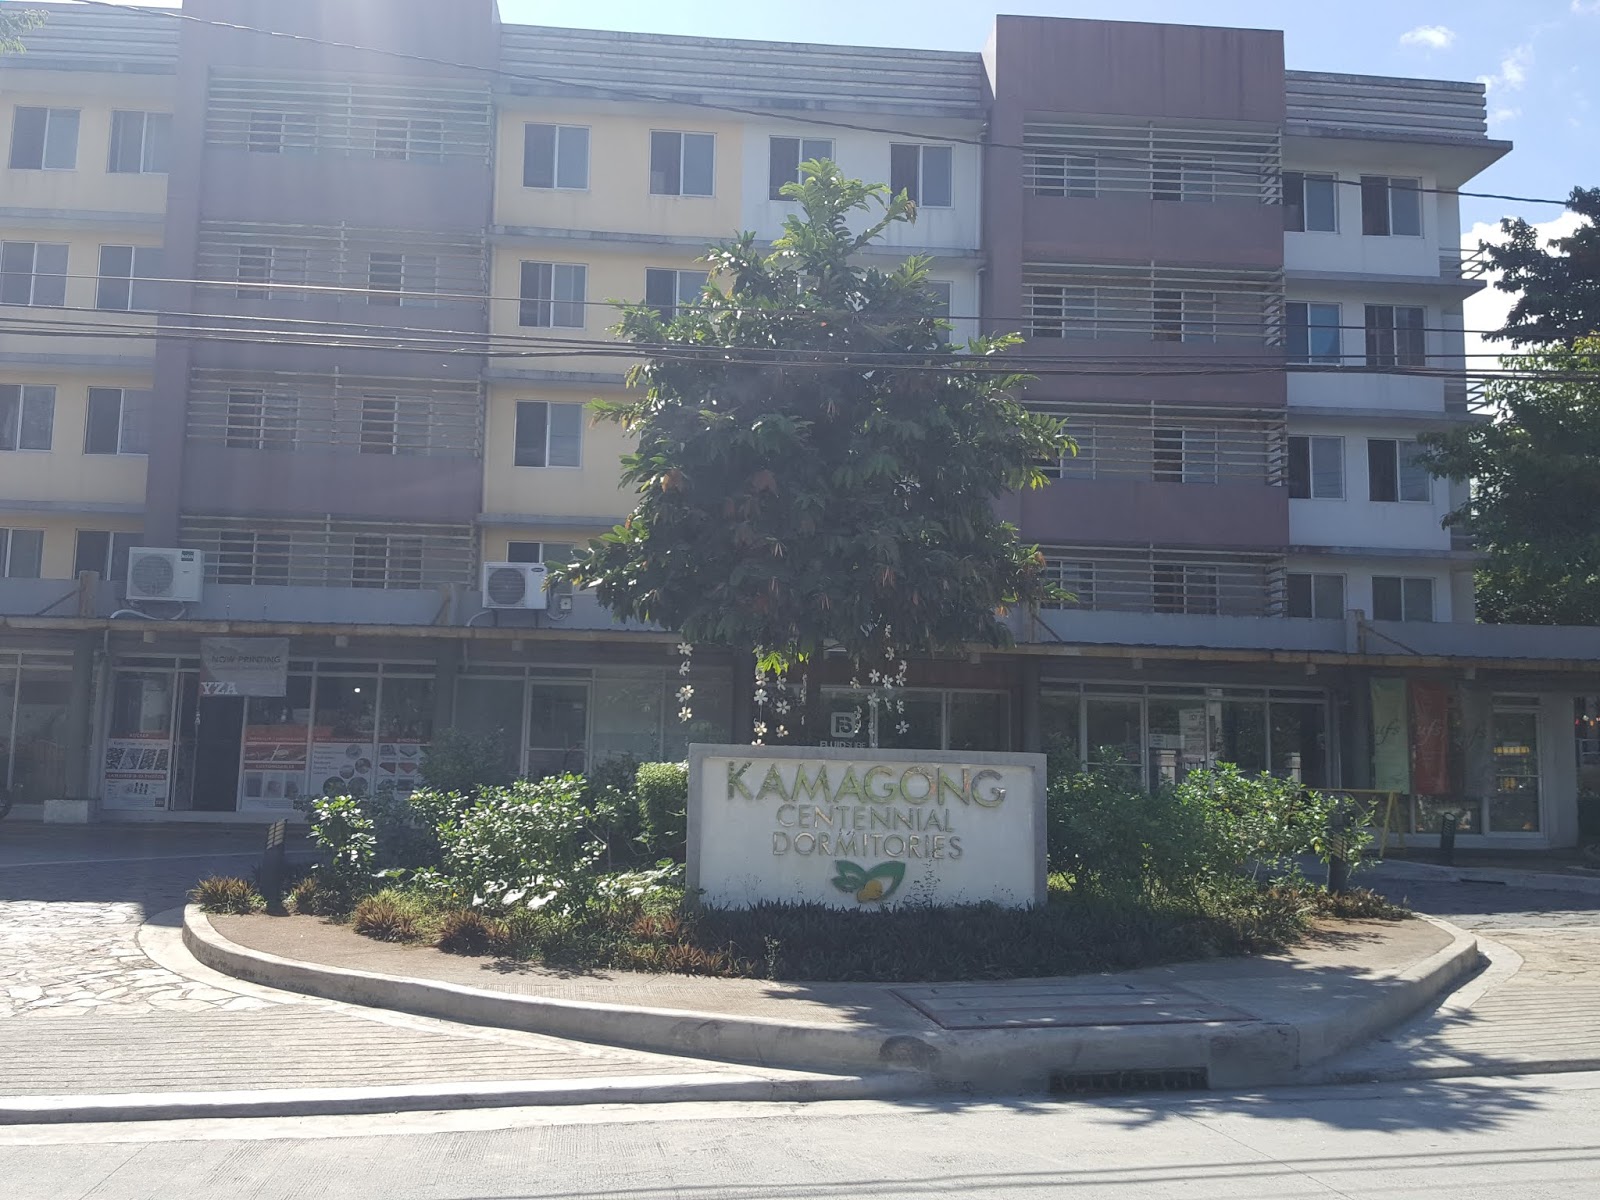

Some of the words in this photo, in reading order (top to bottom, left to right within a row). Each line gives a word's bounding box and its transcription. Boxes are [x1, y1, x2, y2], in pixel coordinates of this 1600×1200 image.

[212, 655, 235, 663] NOW
[238, 655, 281, 663] PRINTING
[201, 681, 238, 695] YZA
[725, 760, 1007, 808] KAMAGONG
[776, 804, 956, 833] CENTENNIAL
[772, 831, 963, 860] DORMITORIES
